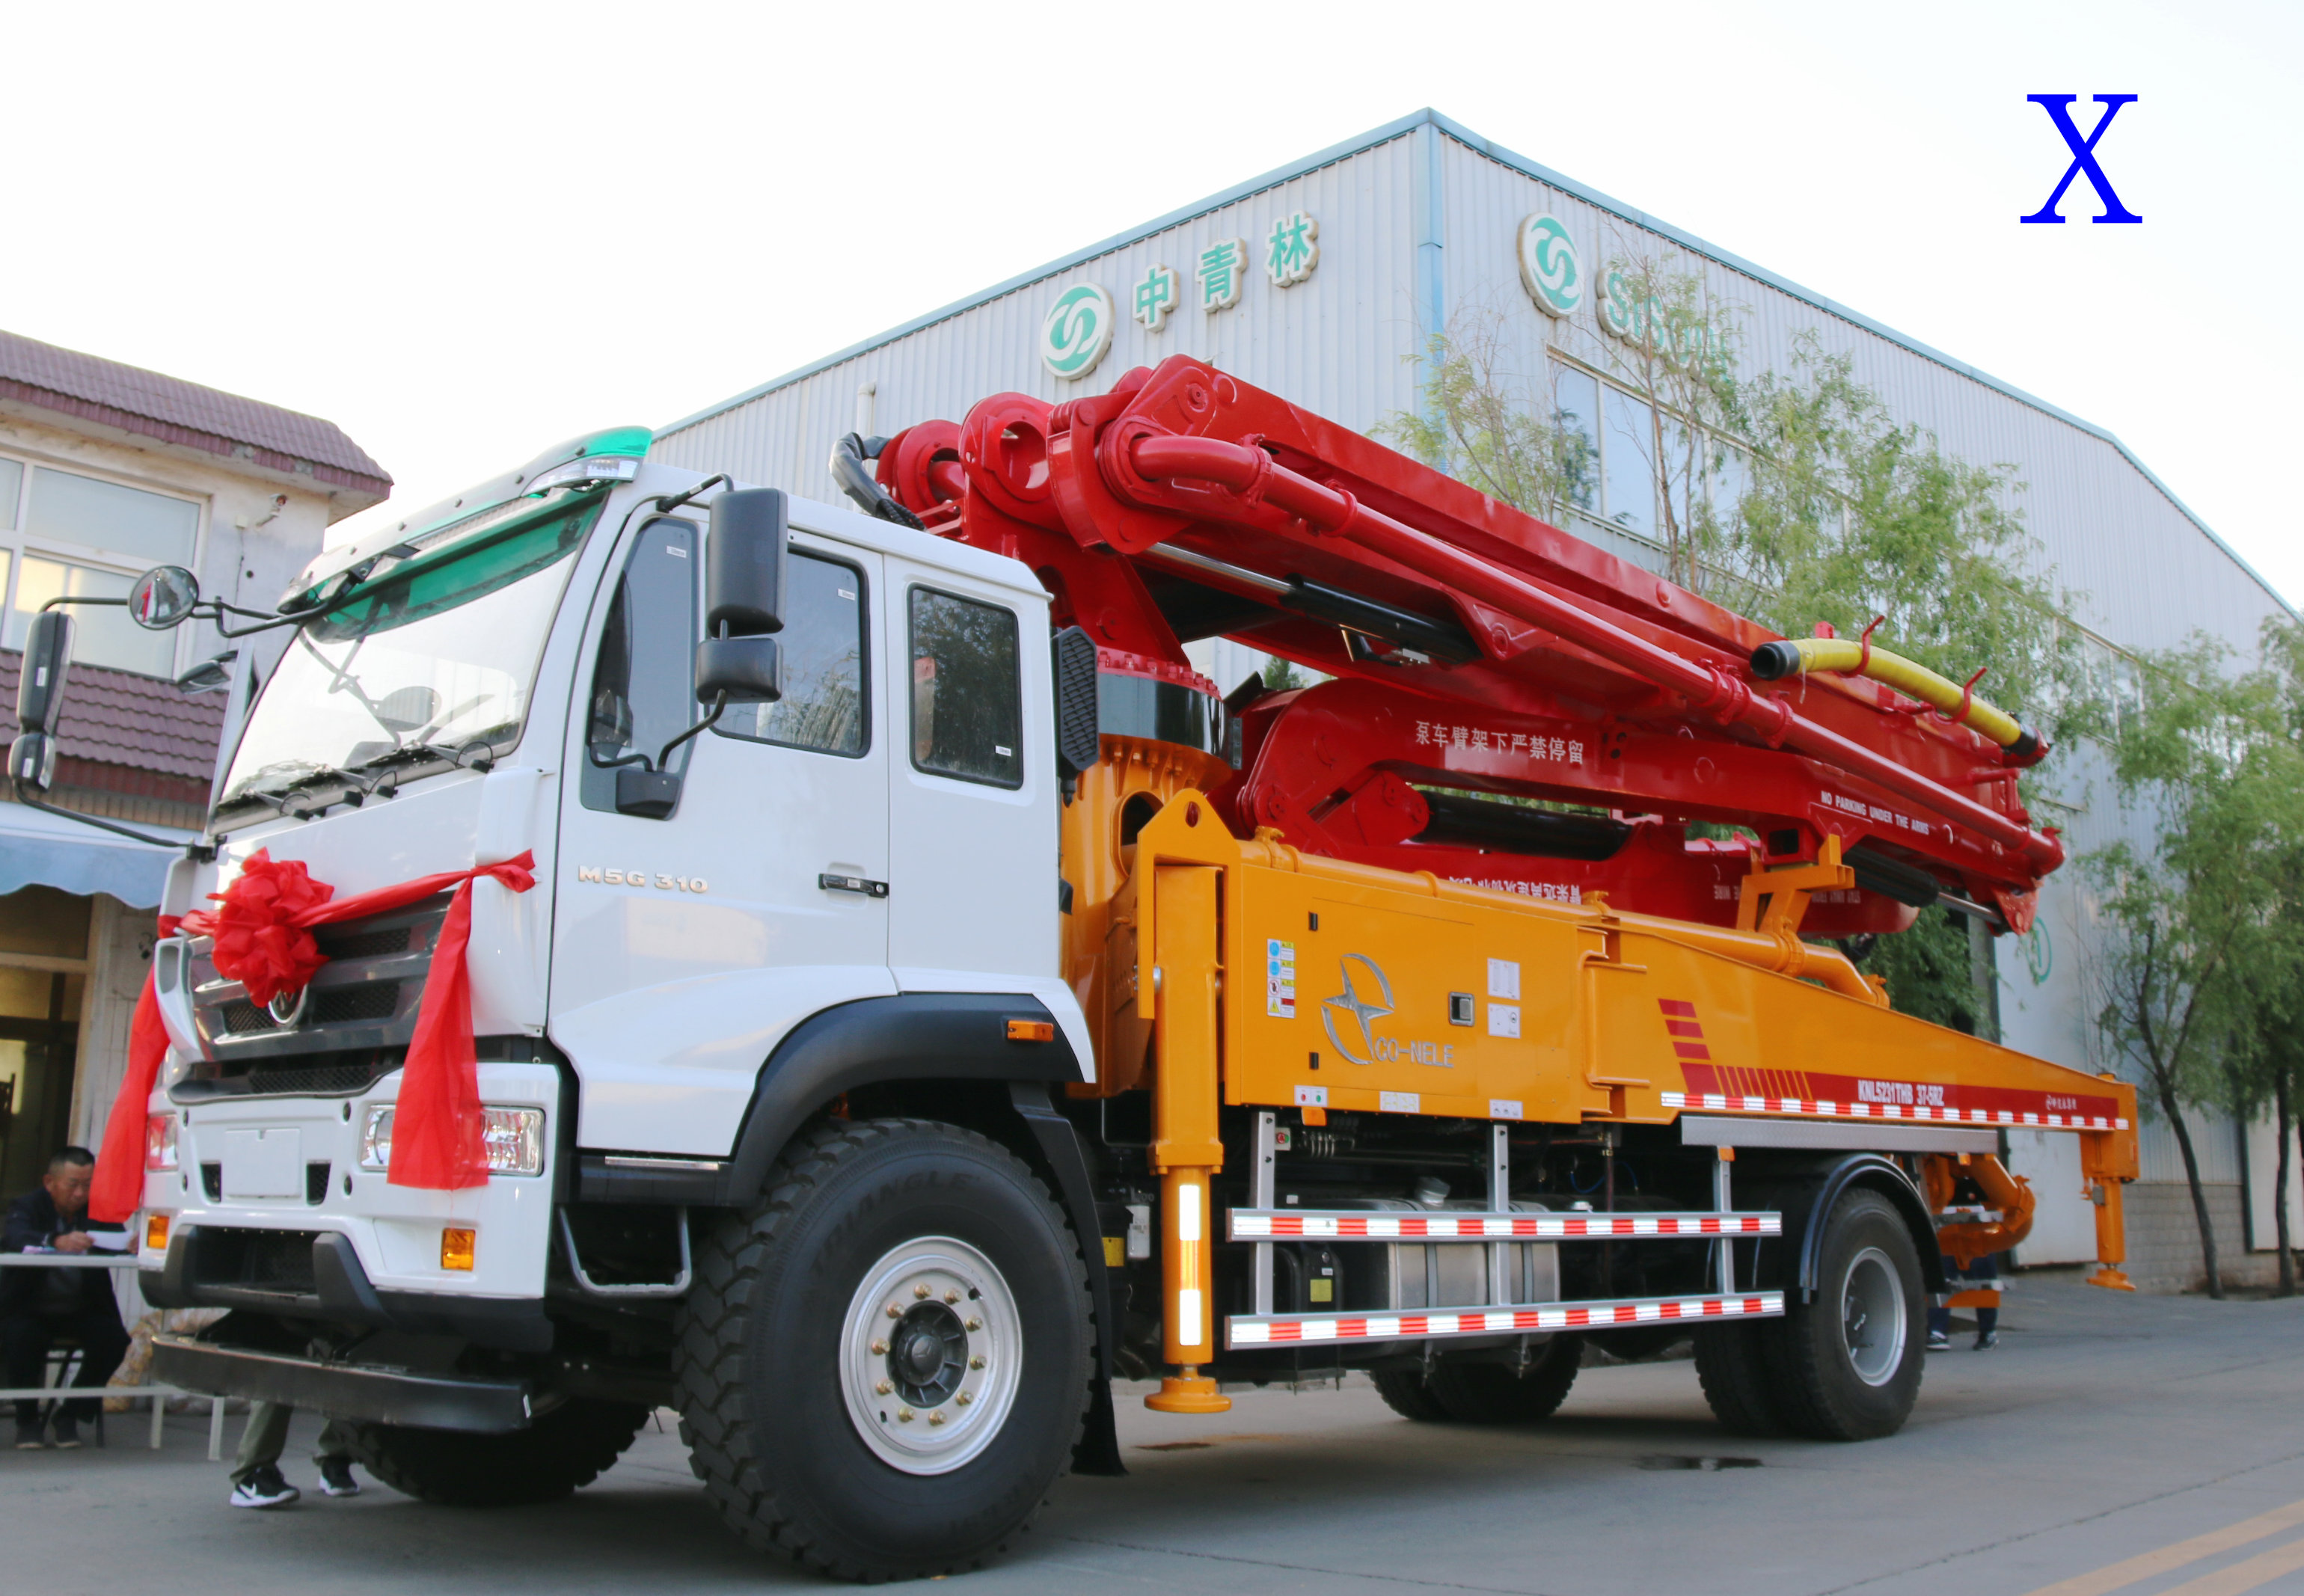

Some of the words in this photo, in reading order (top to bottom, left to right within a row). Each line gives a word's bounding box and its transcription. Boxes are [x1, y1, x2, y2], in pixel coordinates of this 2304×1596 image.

[1136, 213, 1311, 325] 中青林
[1415, 720, 1584, 765] 泵车臂架下严禁停留
[1821, 790, 1833, 805] NO
[1835, 795, 1867, 816] PARKING
[1869, 805, 1893, 824] UNDER
[1895, 814, 1909, 829] THE
[1911, 819, 1930, 835] ARMS
[578, 865, 646, 887] M5G
[654, 872, 708, 894] 310
[1374, 1036, 1454, 1068] CO-NELE
[1857, 1079, 1914, 1105] KNL5231THB
